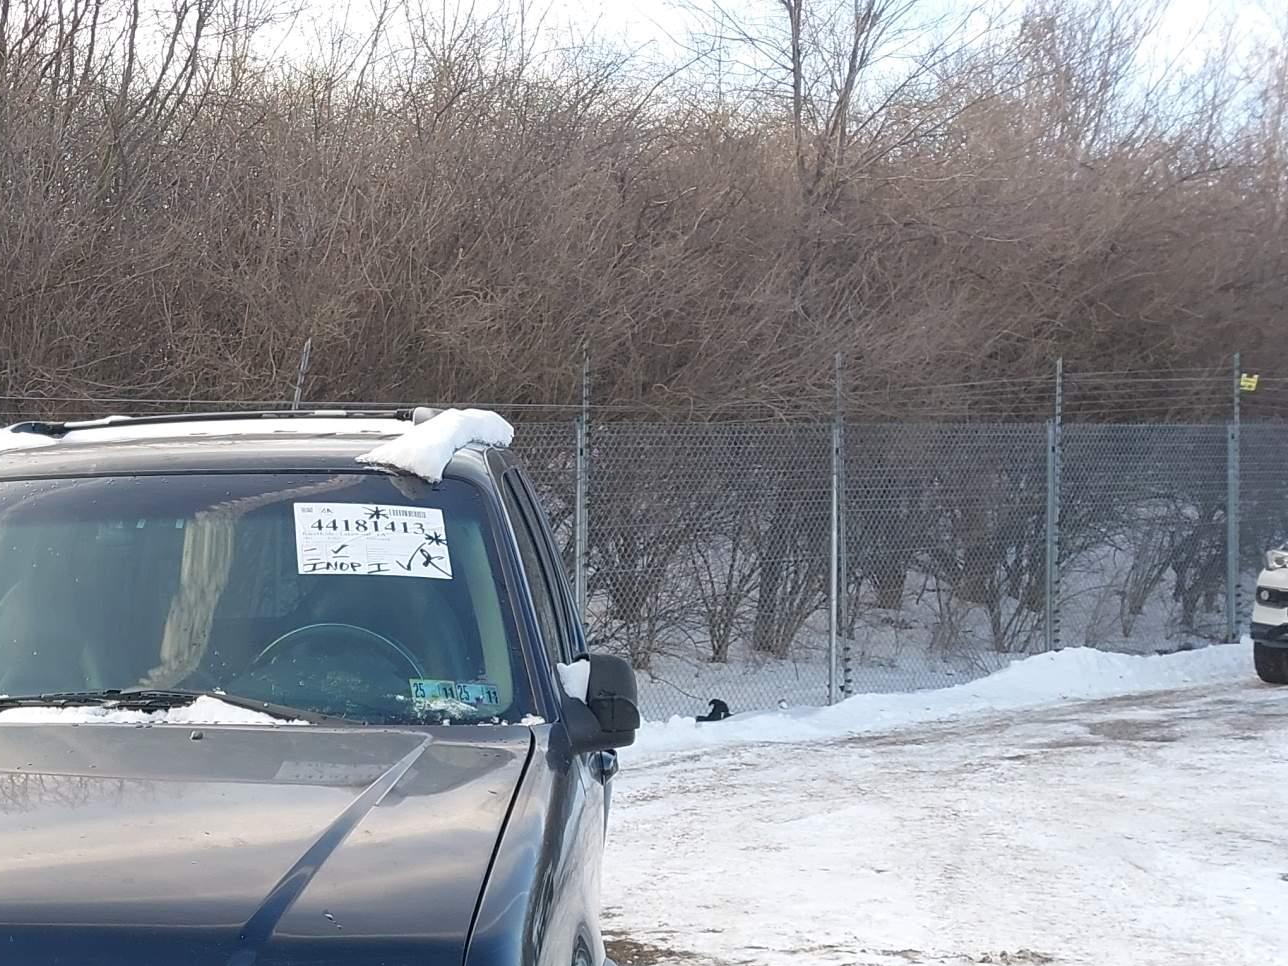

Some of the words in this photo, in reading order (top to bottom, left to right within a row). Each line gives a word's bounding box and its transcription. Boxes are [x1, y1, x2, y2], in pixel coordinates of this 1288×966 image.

[311, 518, 425, 535] 44181413
[303, 561, 362, 572] INOP
[413, 682, 426, 698] 25
[443, 687, 455, 699] 11
[457, 685, 470, 701] 25
[486, 690, 499, 704] 11
